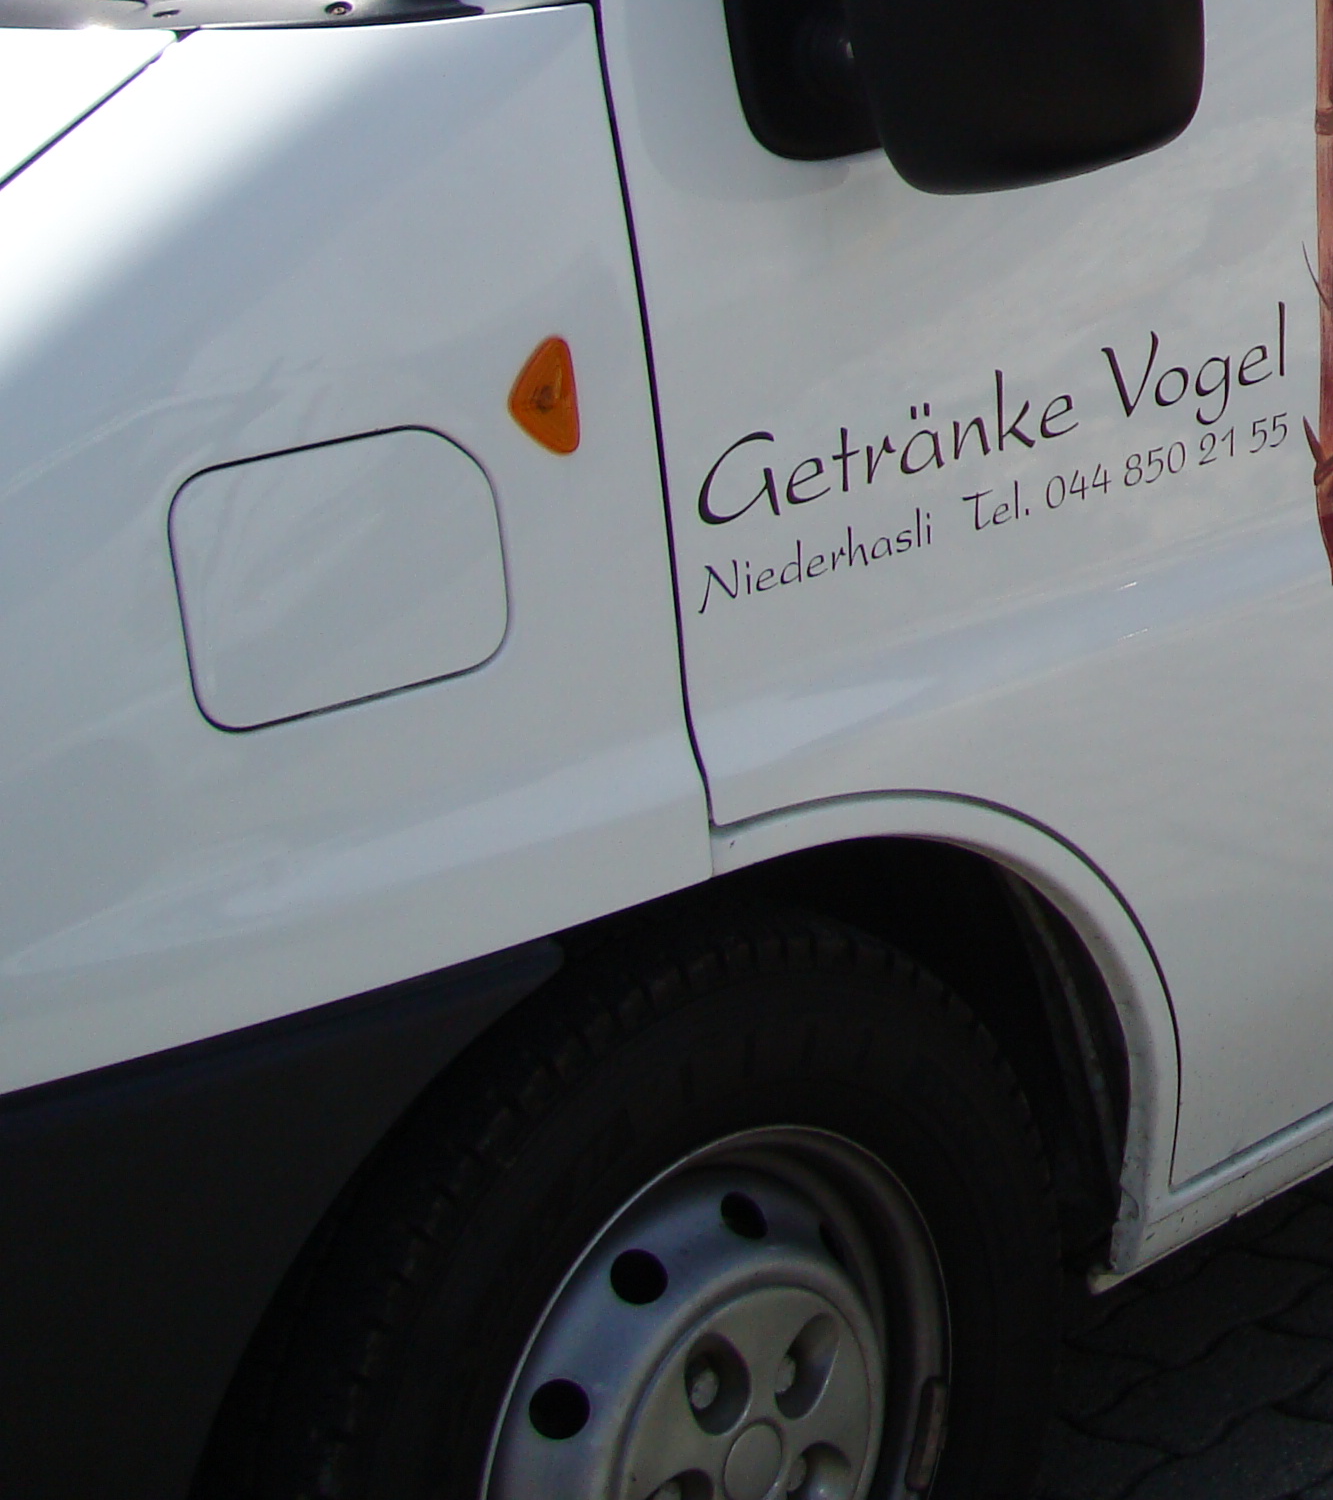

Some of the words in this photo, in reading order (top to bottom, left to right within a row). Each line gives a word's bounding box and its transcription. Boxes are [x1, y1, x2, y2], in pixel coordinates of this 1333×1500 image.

[698, 368, 1080, 525] Getränke
[1101, 301, 1287, 426] Vogel
[698, 509, 934, 613] Niederhasli
[962, 479, 1032, 532] Tel.
[1045, 463, 1114, 510] 044
[1123, 441, 1188, 488] 850
[1198, 425, 1237, 466] 21
[1249, 412, 1289, 455] 55
